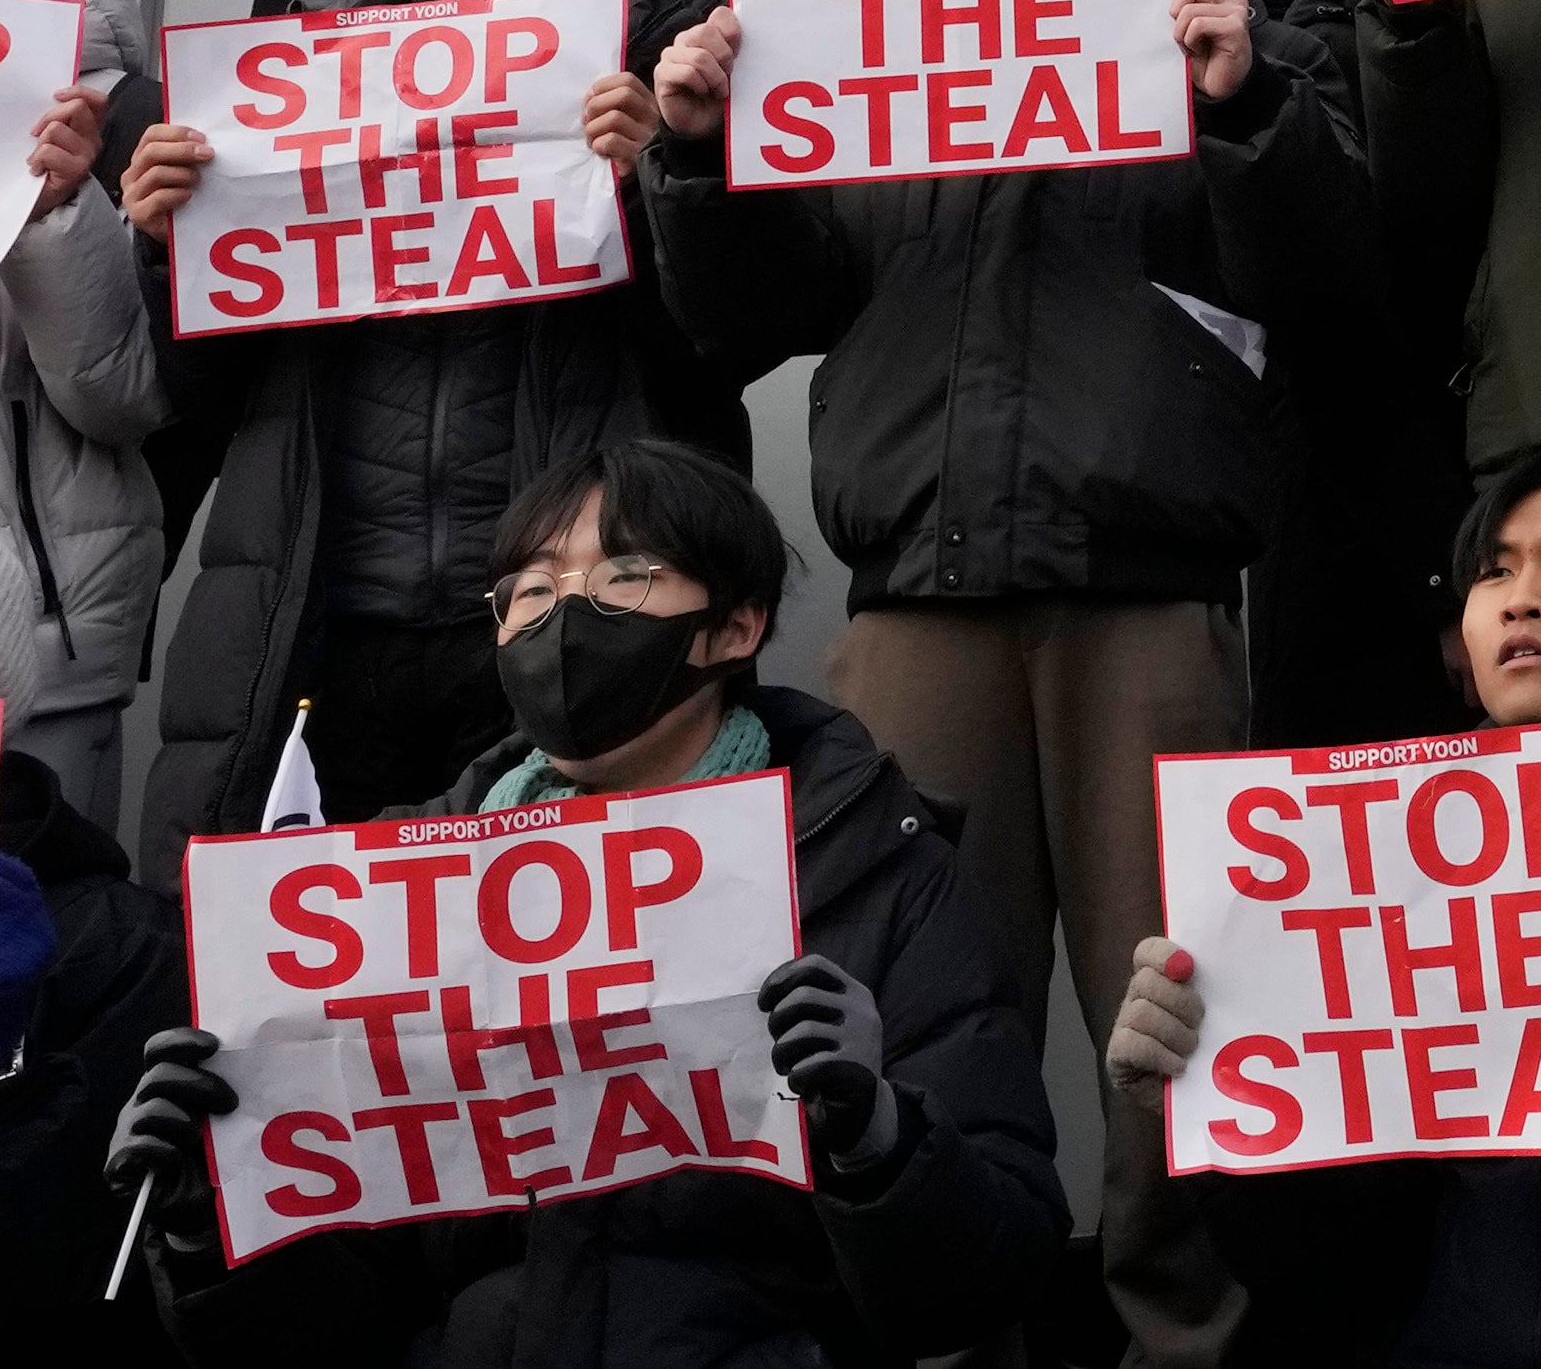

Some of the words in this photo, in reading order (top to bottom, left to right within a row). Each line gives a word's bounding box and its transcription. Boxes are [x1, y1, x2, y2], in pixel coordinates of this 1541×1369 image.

[336, 7, 413, 26] SUPPORT
[414, 2, 459, 19] YOON
[231, 17, 559, 131] STOP
[758, 59, 1163, 175] STEAL
[273, 109, 519, 216] THE
[207, 198, 602, 319] STEAL
[1328, 743, 1421, 771] SUPPORT
[1422, 736, 1478, 762] YOON
[398, 816, 496, 845] SUPPORT
[498, 806, 563, 834] YOON
[266, 826, 704, 990] STOP
[324, 959, 668, 1099] THE
[260, 1068, 779, 1219] STEAL
